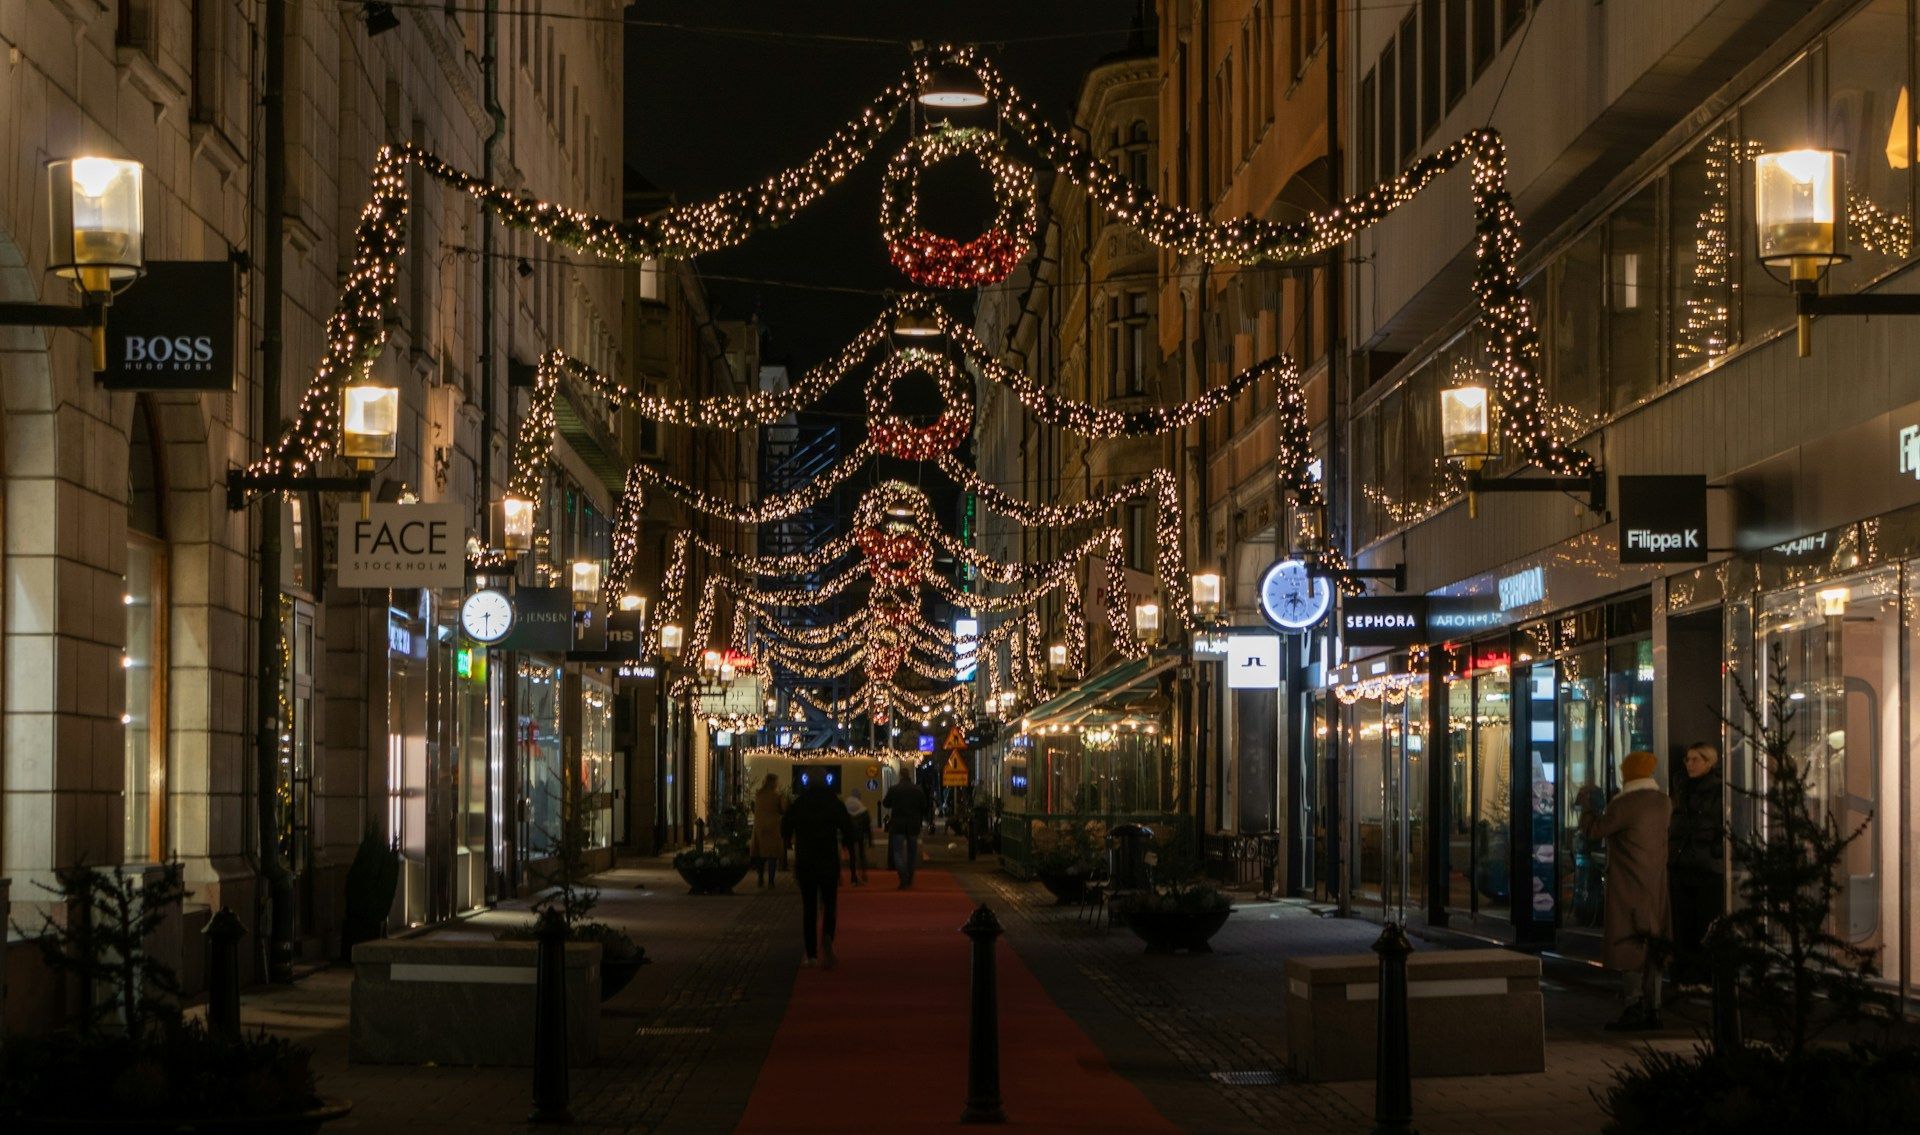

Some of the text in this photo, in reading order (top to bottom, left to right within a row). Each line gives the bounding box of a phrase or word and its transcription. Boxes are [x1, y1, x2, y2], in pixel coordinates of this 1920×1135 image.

[125, 335, 213, 361] BOSS
[355, 520, 447, 555] FACE
[1627, 528, 1699, 553] Filippa K
[354, 562, 447, 570] STOCKHOLM
[526, 611, 568, 623] JENSEN
[1346, 614, 1416, 628] SEPHORA
